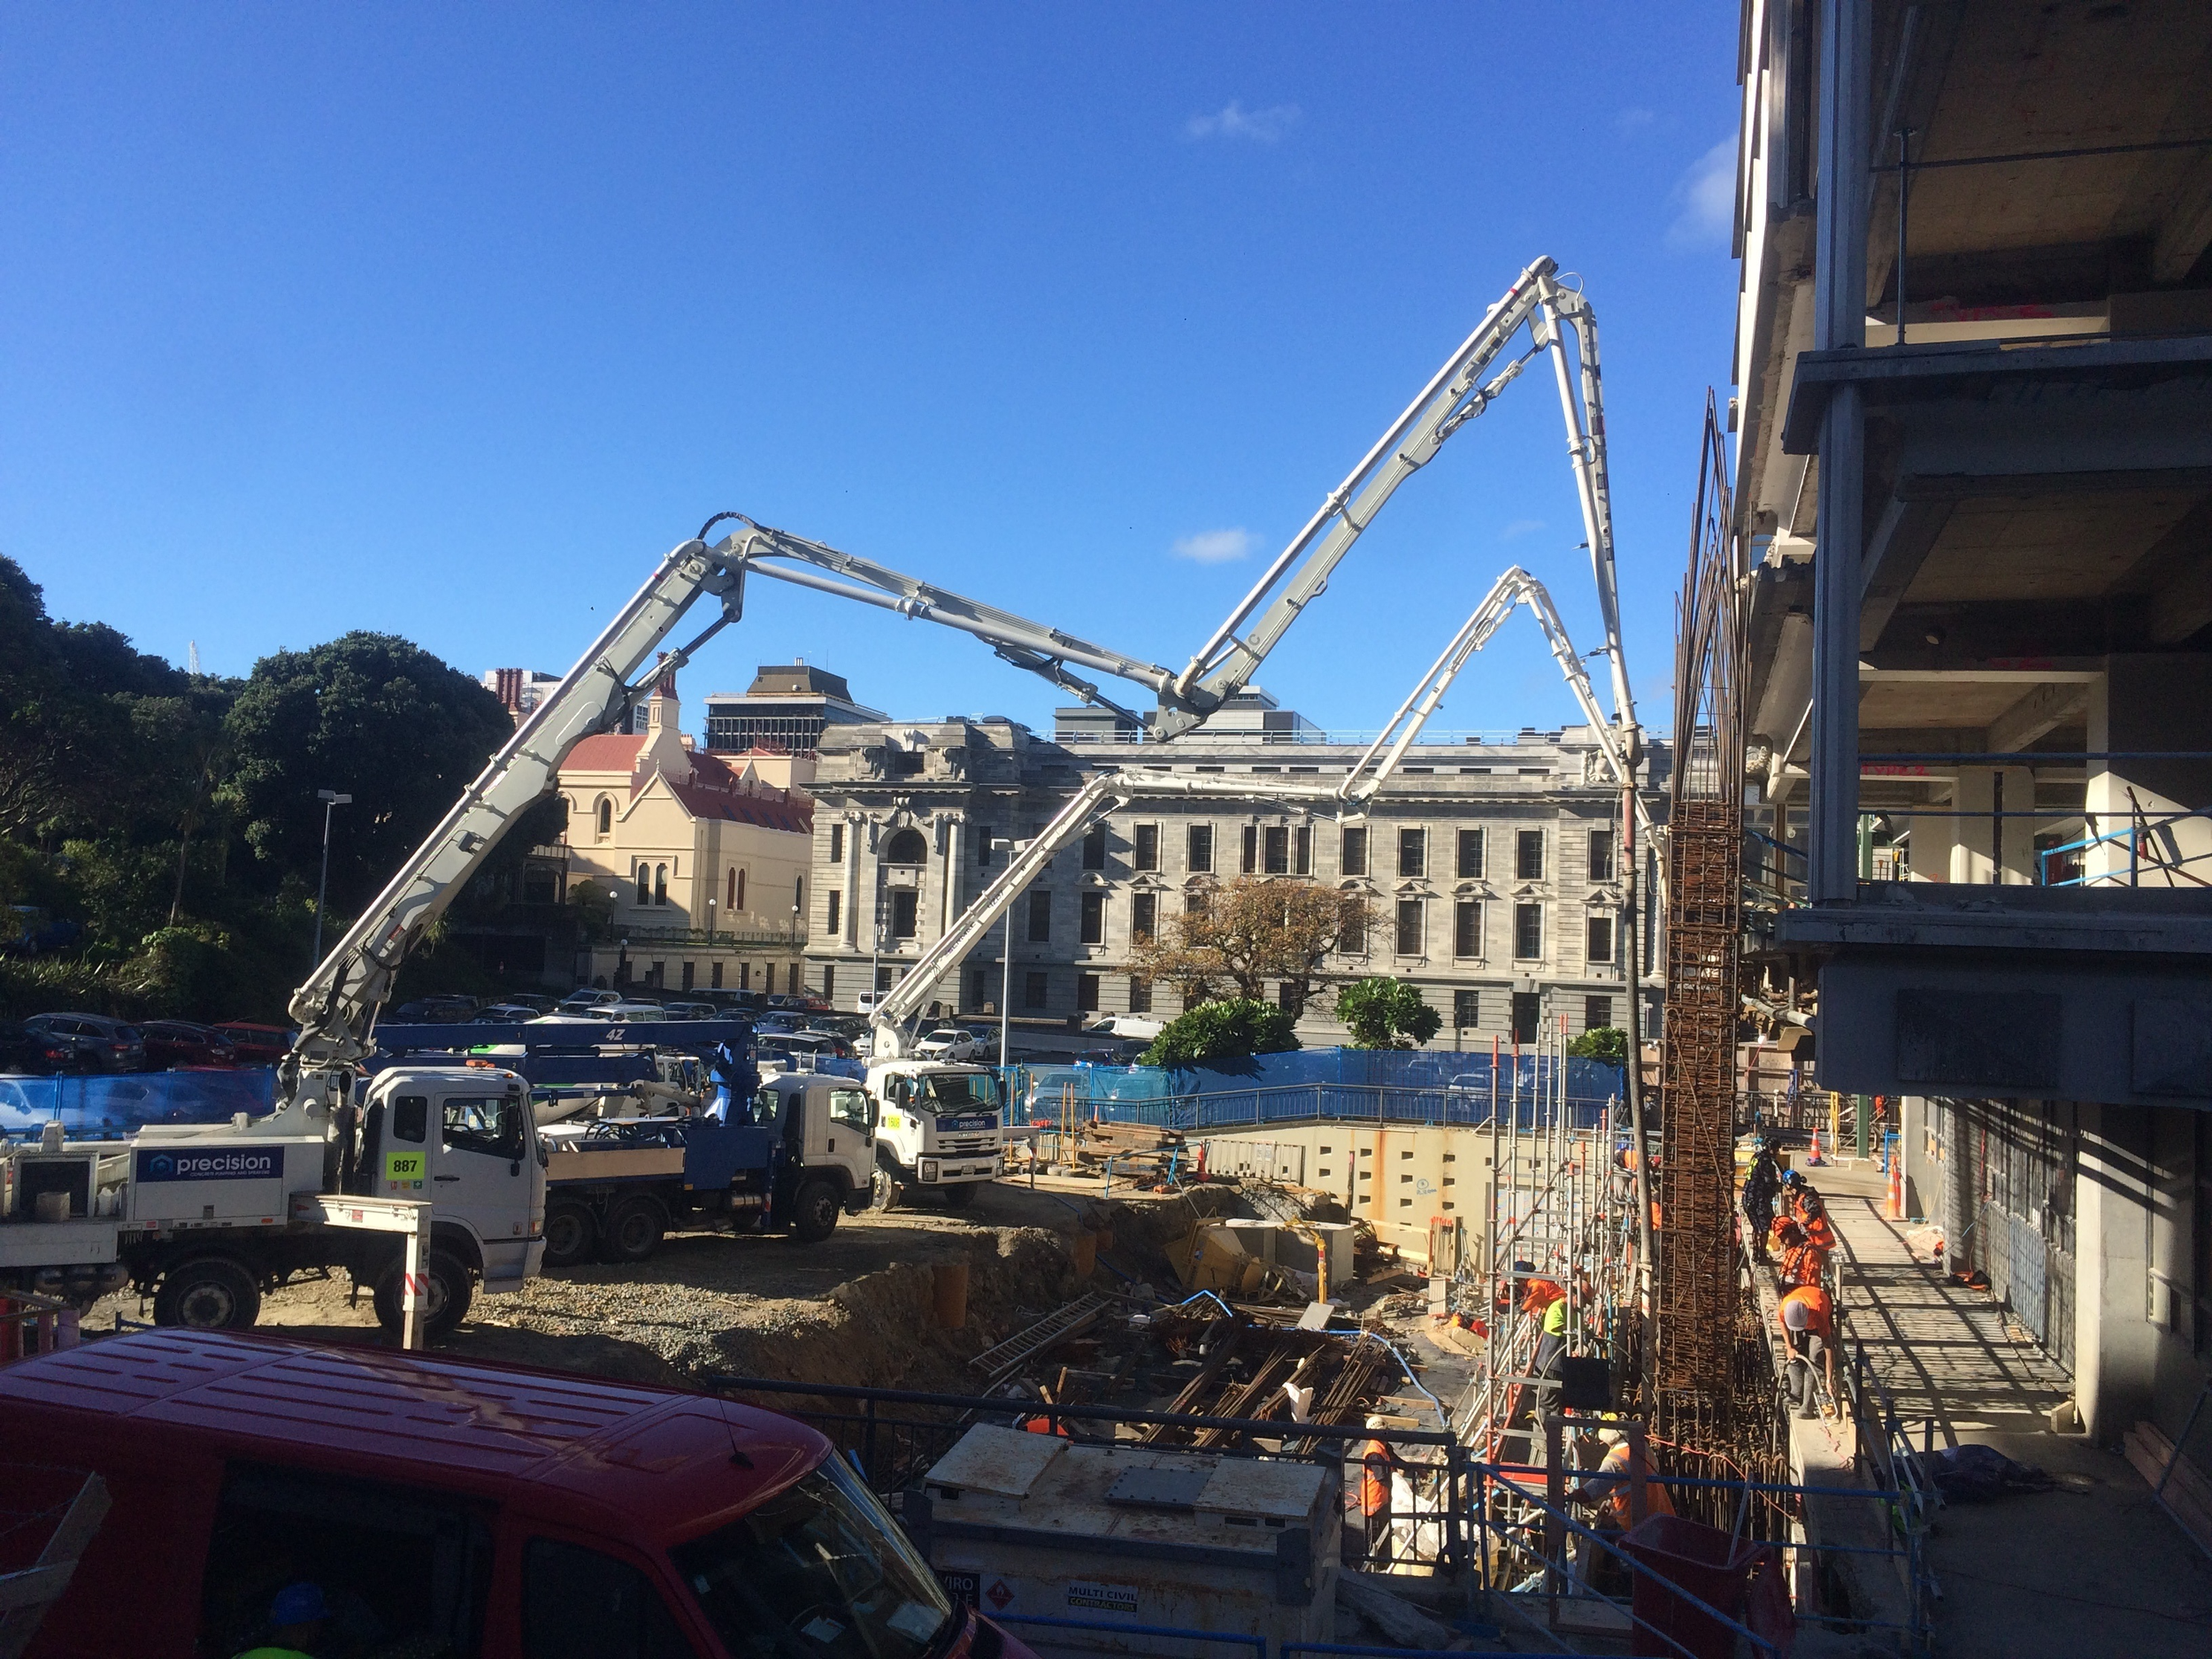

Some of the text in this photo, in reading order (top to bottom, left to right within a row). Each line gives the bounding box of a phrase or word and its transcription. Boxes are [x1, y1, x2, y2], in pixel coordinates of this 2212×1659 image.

[1248, 634, 1261, 646] C
[958, 1119, 986, 1129] precision
[177, 1154, 271, 1175] precision
[393, 1159, 418, 1172] 887
[1068, 1586, 1137, 1602] MULTI CIVIL
[1070, 1597, 1135, 1611] CONTRACTORS
